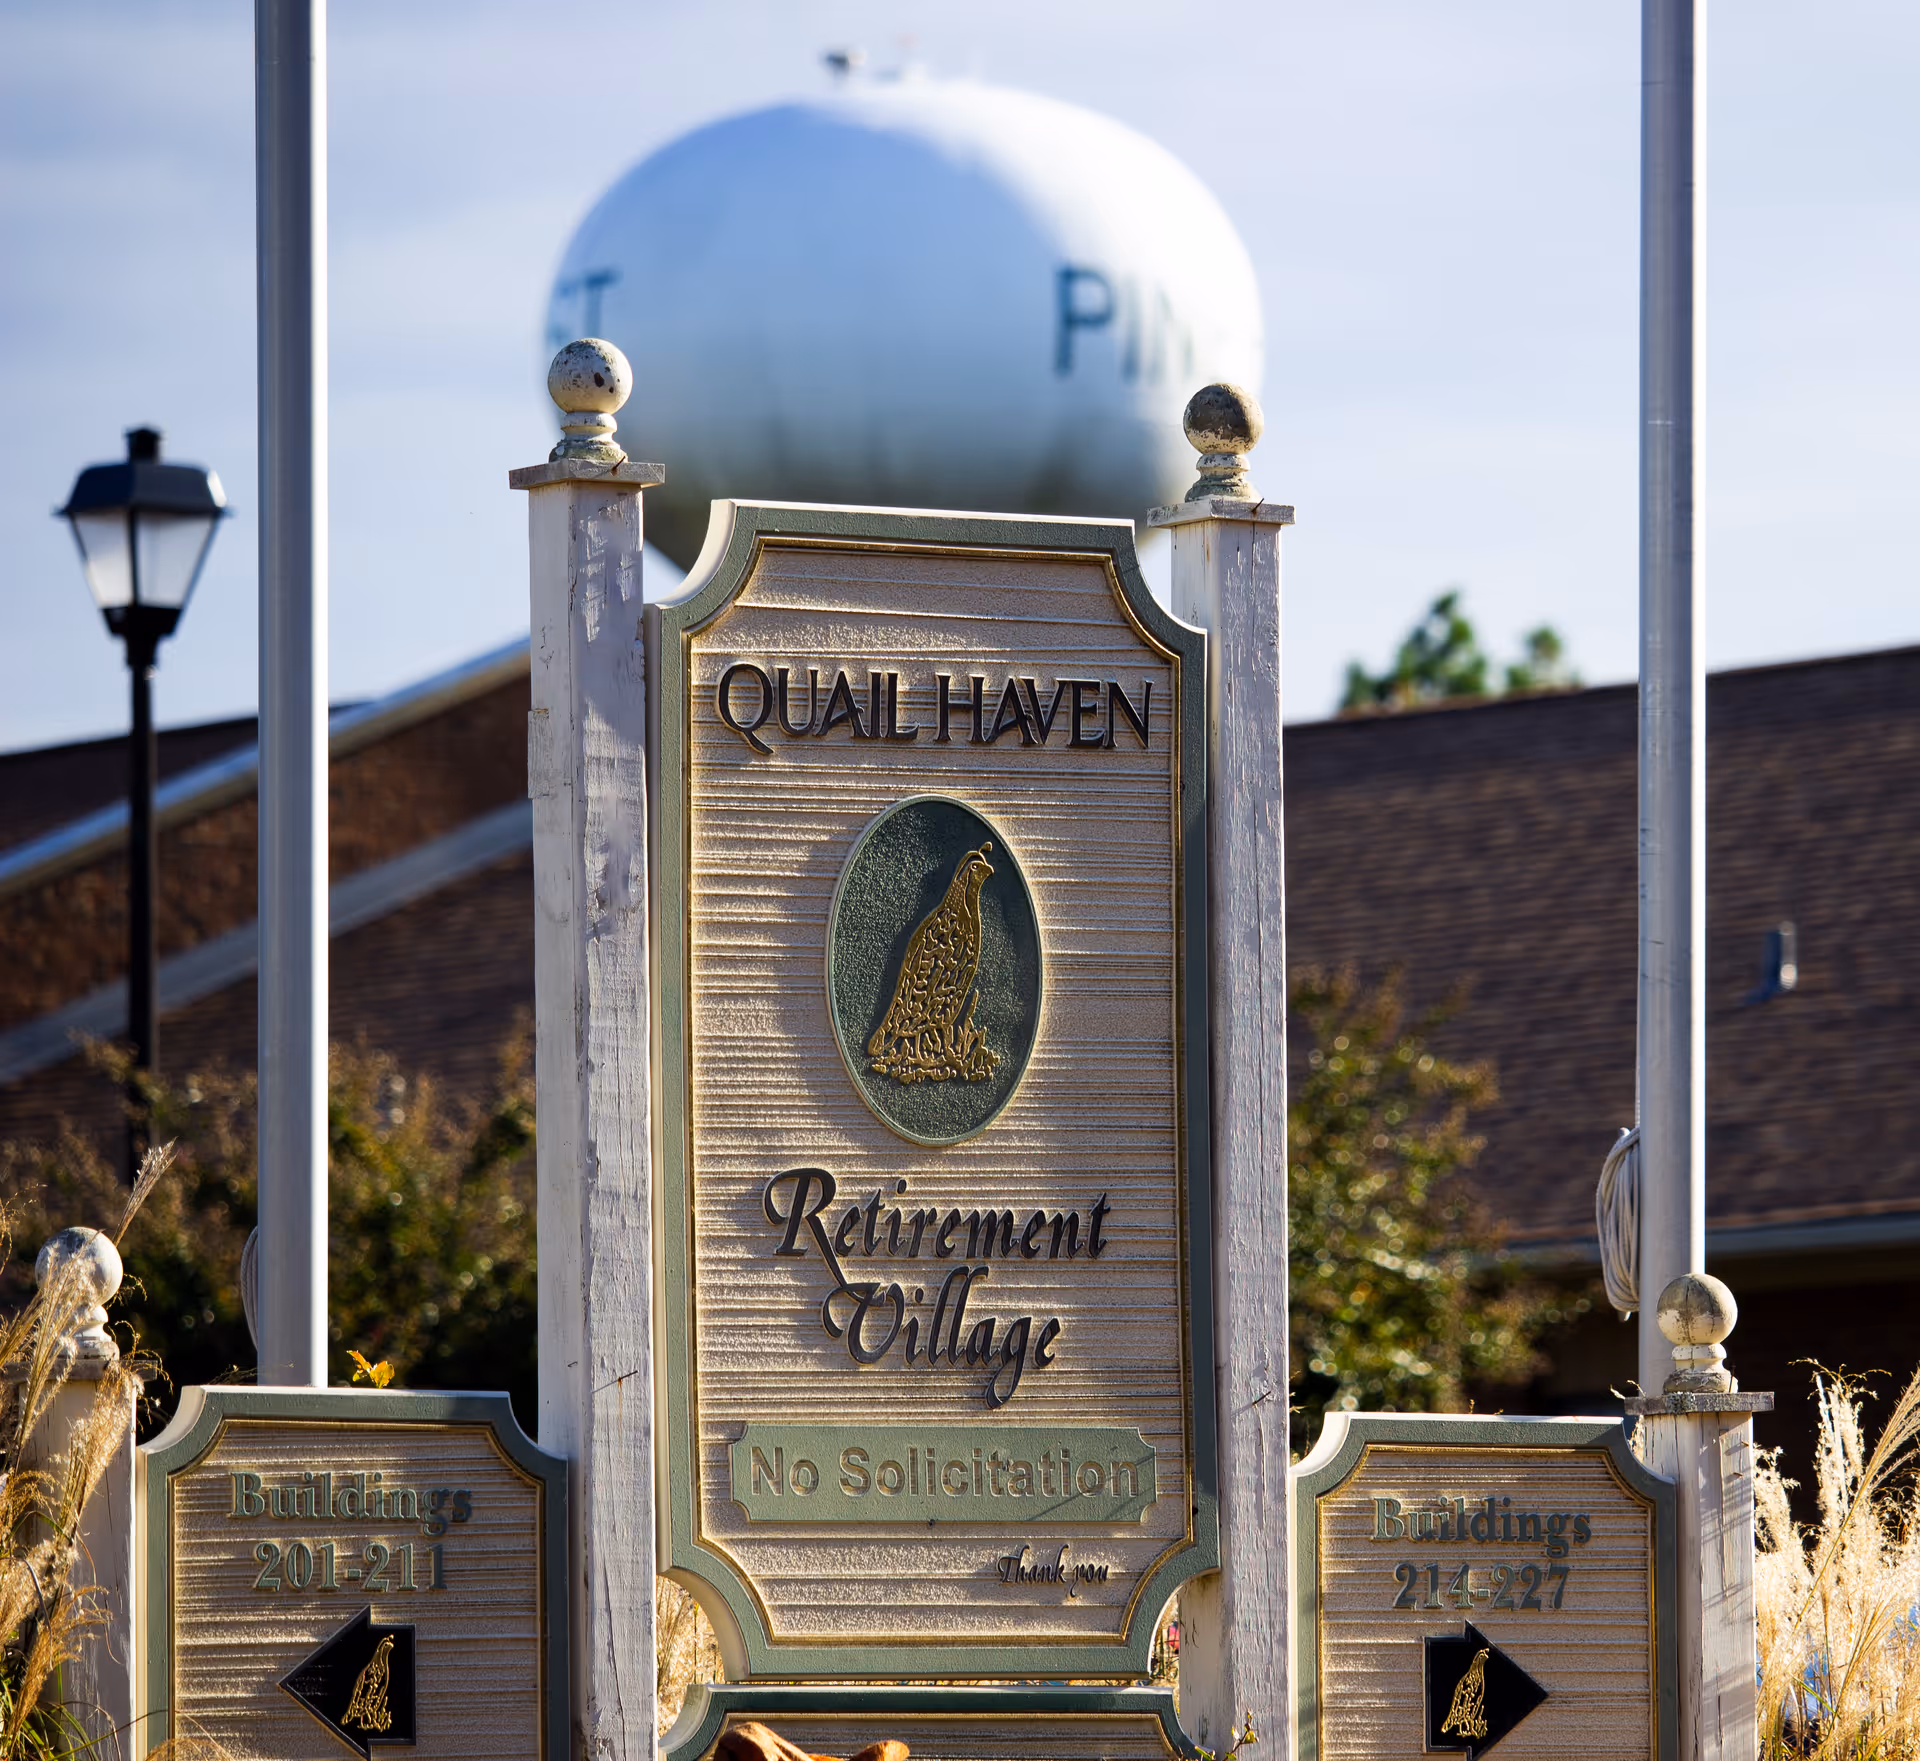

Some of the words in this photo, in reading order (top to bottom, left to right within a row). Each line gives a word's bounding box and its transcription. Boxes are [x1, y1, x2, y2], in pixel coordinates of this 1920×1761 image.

[717, 663, 920, 755] QUAIL
[935, 673, 1155, 750] HAVEN
[763, 1167, 1112, 1280] Retirement
[821, 1265, 1062, 1411] Village
[227, 1471, 474, 1537] Buildings
[750, 1447, 820, 1497] No
[838, 1447, 1139, 1498] Solicitation
[1371, 1496, 1593, 1559] Buildings
[253, 1542, 449, 1593] 201-211
[997, 1543, 1070, 1585] Thank
[1070, 1561, 1110, 1599] you
[1393, 1562, 1571, 1612] 214-227
